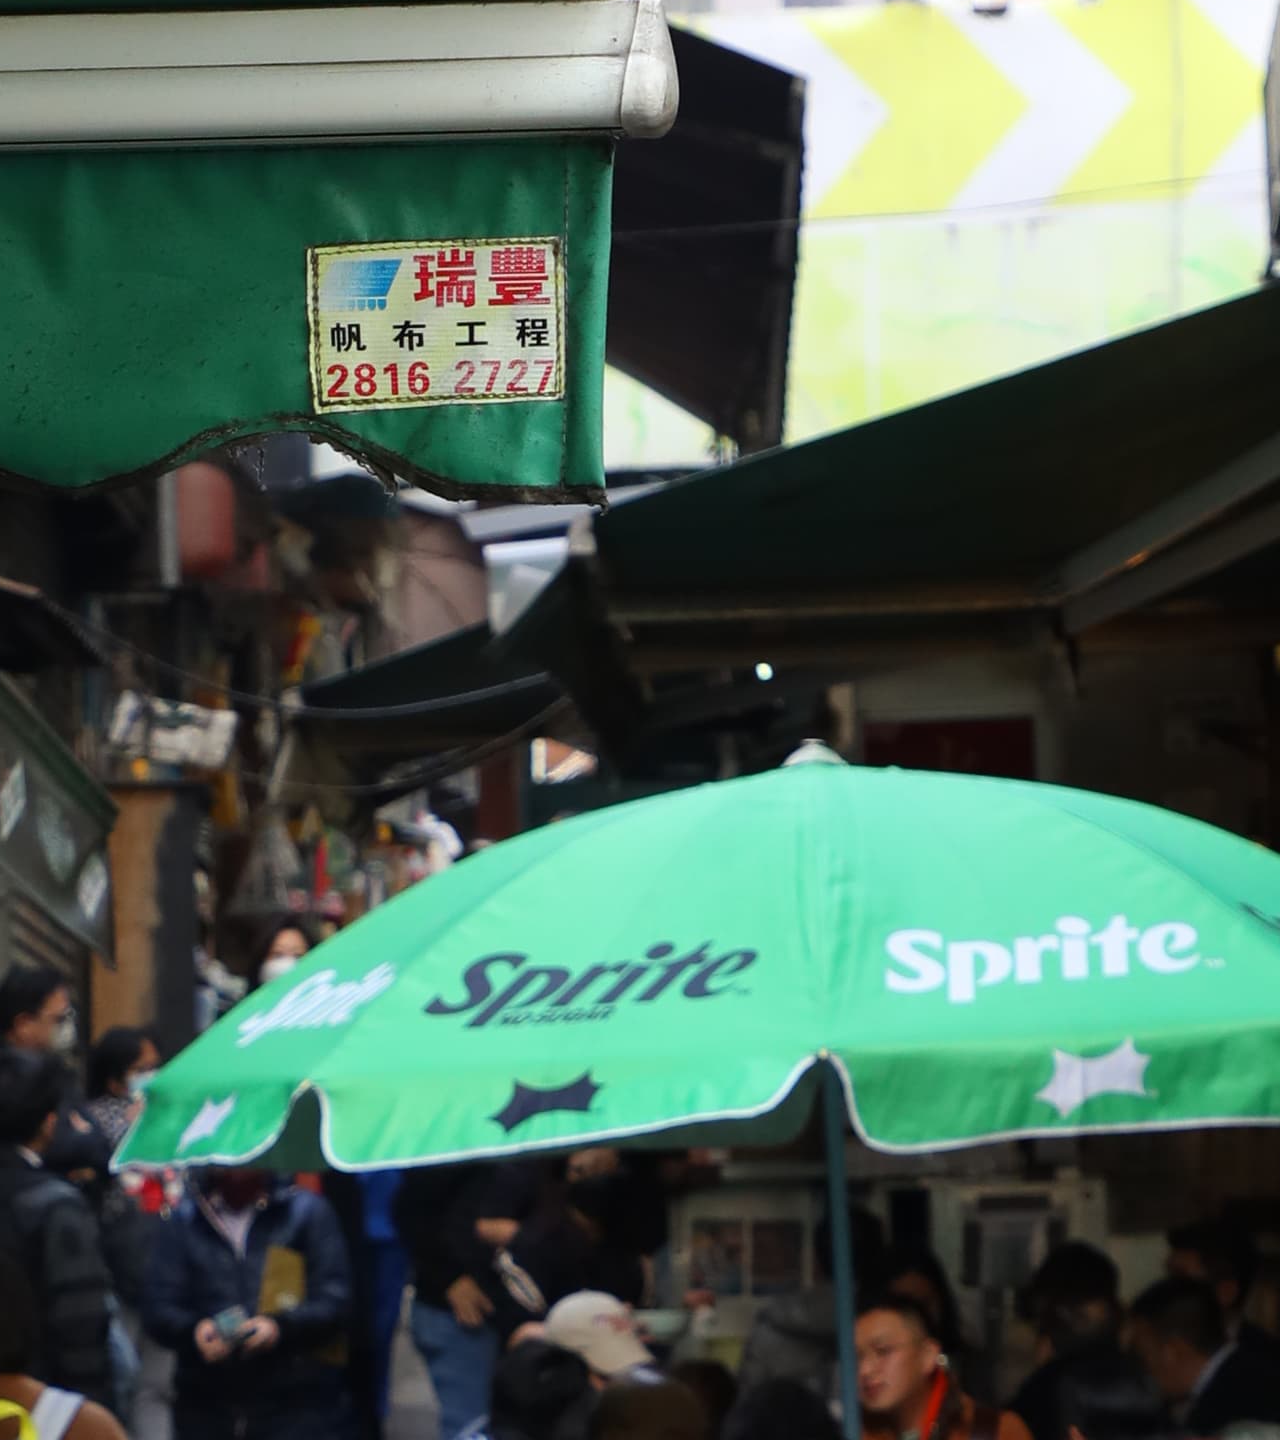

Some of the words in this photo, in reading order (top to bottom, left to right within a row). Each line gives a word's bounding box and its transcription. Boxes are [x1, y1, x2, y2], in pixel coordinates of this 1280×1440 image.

[413, 247, 551, 308] 瑞豐
[330, 318, 550, 353] 帆布工程
[326, 361, 430, 398] 2816
[454, 359, 554, 395] 2727
[424, 940, 758, 1029] Sprite
[884, 914, 1201, 1003] Sprite
